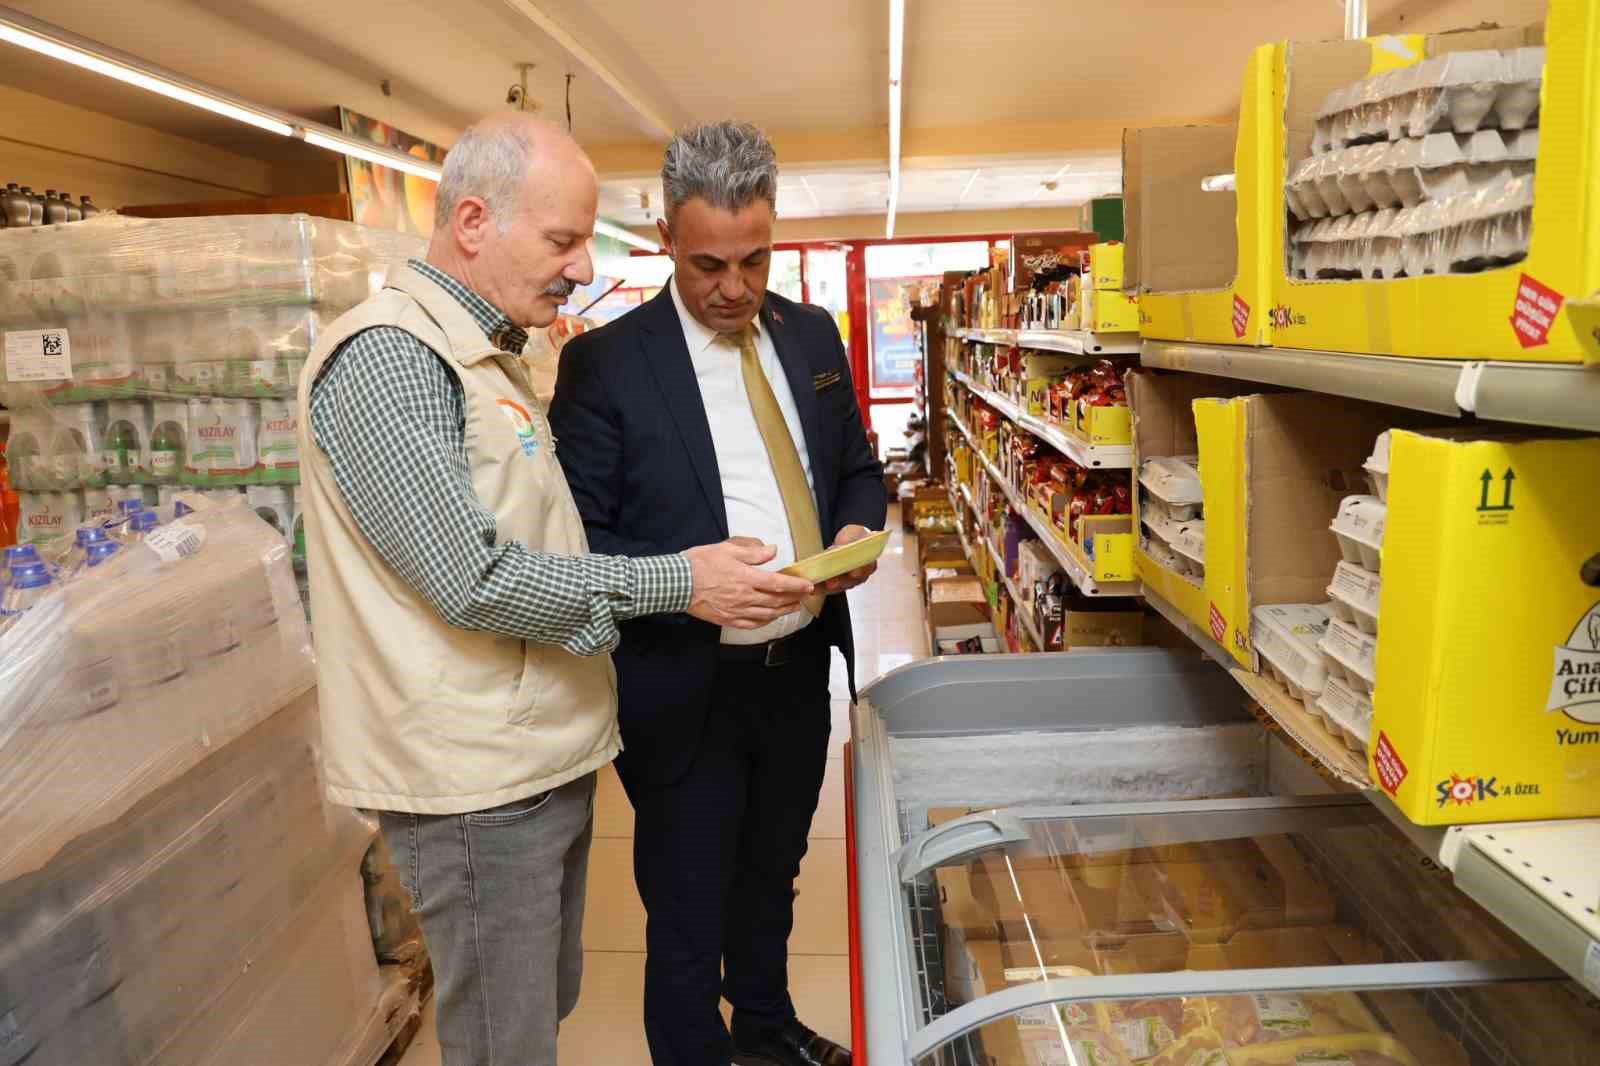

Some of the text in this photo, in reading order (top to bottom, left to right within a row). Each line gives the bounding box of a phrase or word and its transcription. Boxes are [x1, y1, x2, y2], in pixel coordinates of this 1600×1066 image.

[198, 426, 236, 437] KIZILAY
[28, 514, 63, 527] KIZILAY
[1556, 728, 1599, 746] Yum
[1436, 776, 1498, 808] ŞOK
